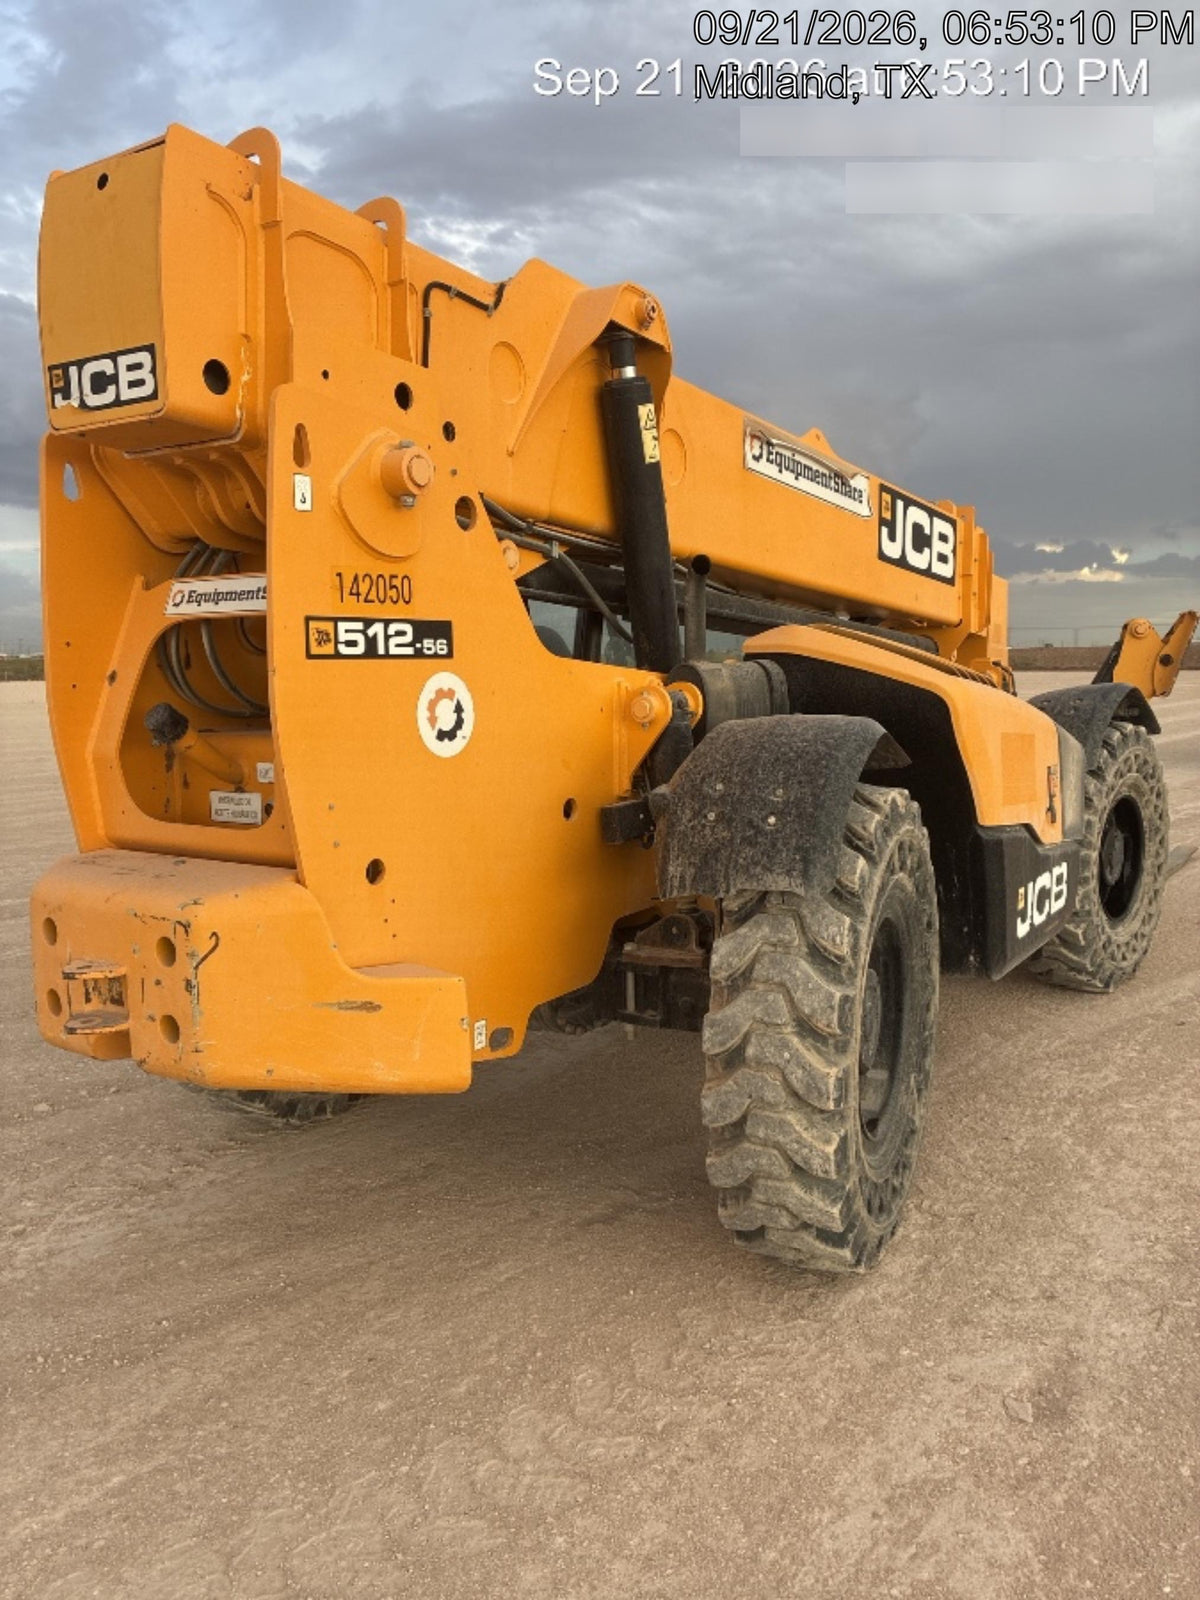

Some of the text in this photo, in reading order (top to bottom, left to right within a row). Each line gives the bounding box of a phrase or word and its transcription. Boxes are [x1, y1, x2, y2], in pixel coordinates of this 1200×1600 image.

[54, 351, 155, 408] JCB
[766, 440, 863, 504] EquipmentShare
[880, 498, 955, 579] JCB
[336, 572, 412, 605] 142050
[1017, 861, 1068, 939] JCB
